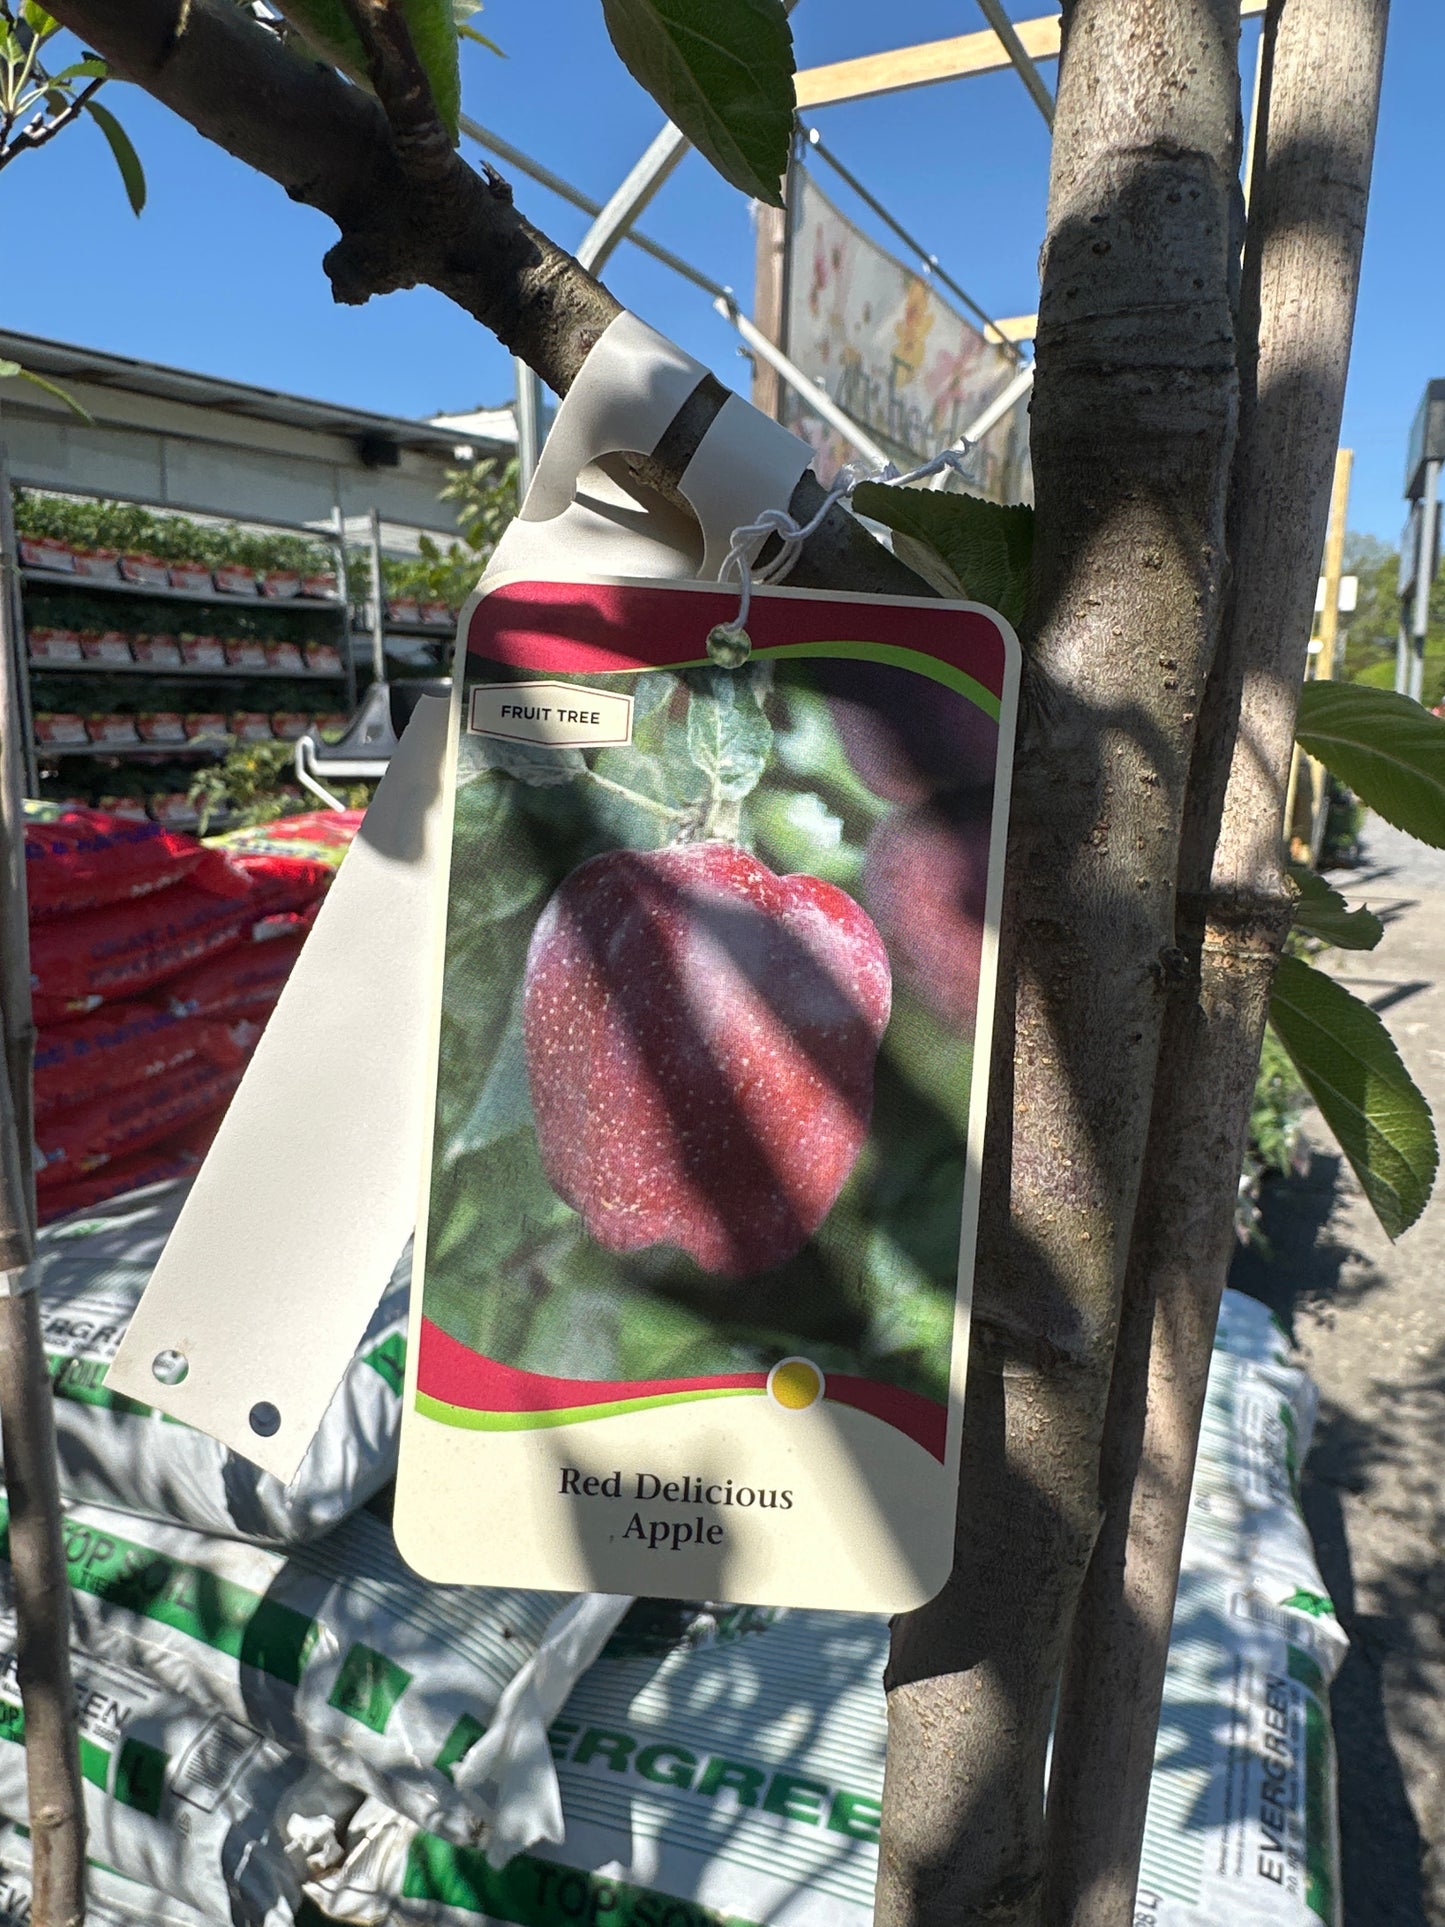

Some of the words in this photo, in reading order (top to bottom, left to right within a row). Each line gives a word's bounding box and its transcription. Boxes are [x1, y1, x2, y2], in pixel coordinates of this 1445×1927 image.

[501, 705, 552, 721] FRUIT
[557, 709, 600, 724] TREE
[558, 1467, 622, 1498] Red
[634, 1472, 794, 1510] Delicious
[622, 1512, 724, 1550] Apple
[1258, 1672, 1289, 1885] EVERGREEN
